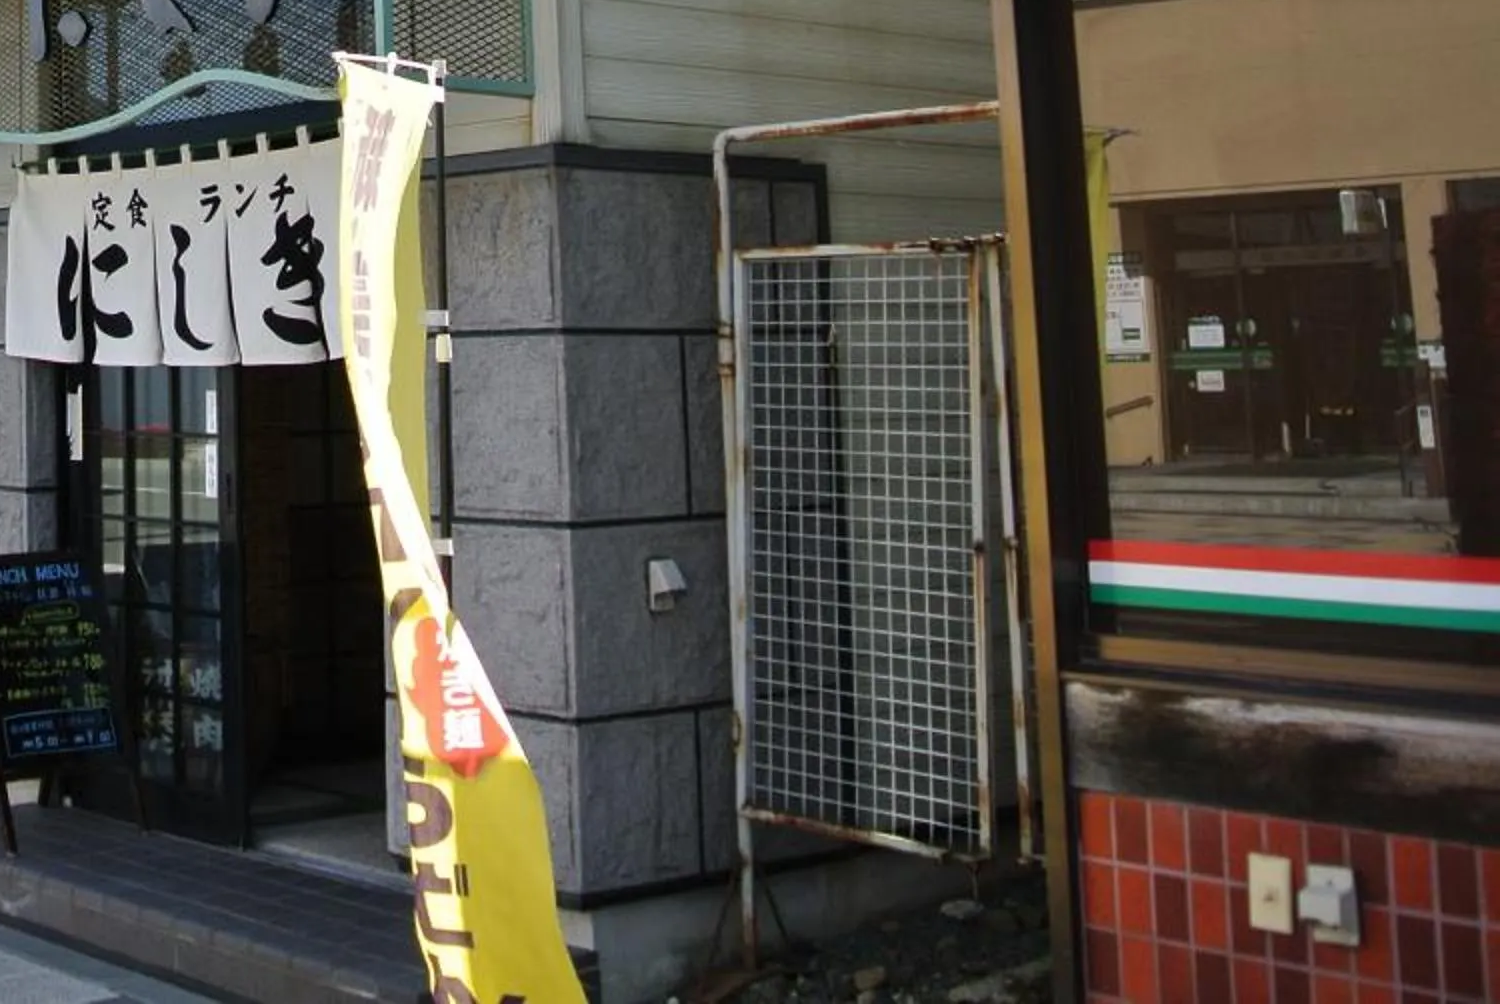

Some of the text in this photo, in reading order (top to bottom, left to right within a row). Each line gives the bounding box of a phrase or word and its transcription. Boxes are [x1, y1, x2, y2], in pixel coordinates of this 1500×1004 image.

[90, 172, 295, 232] 定食 ランチ
[57, 210, 325, 351] にしき
[35, 562, 80, 582] MENU
